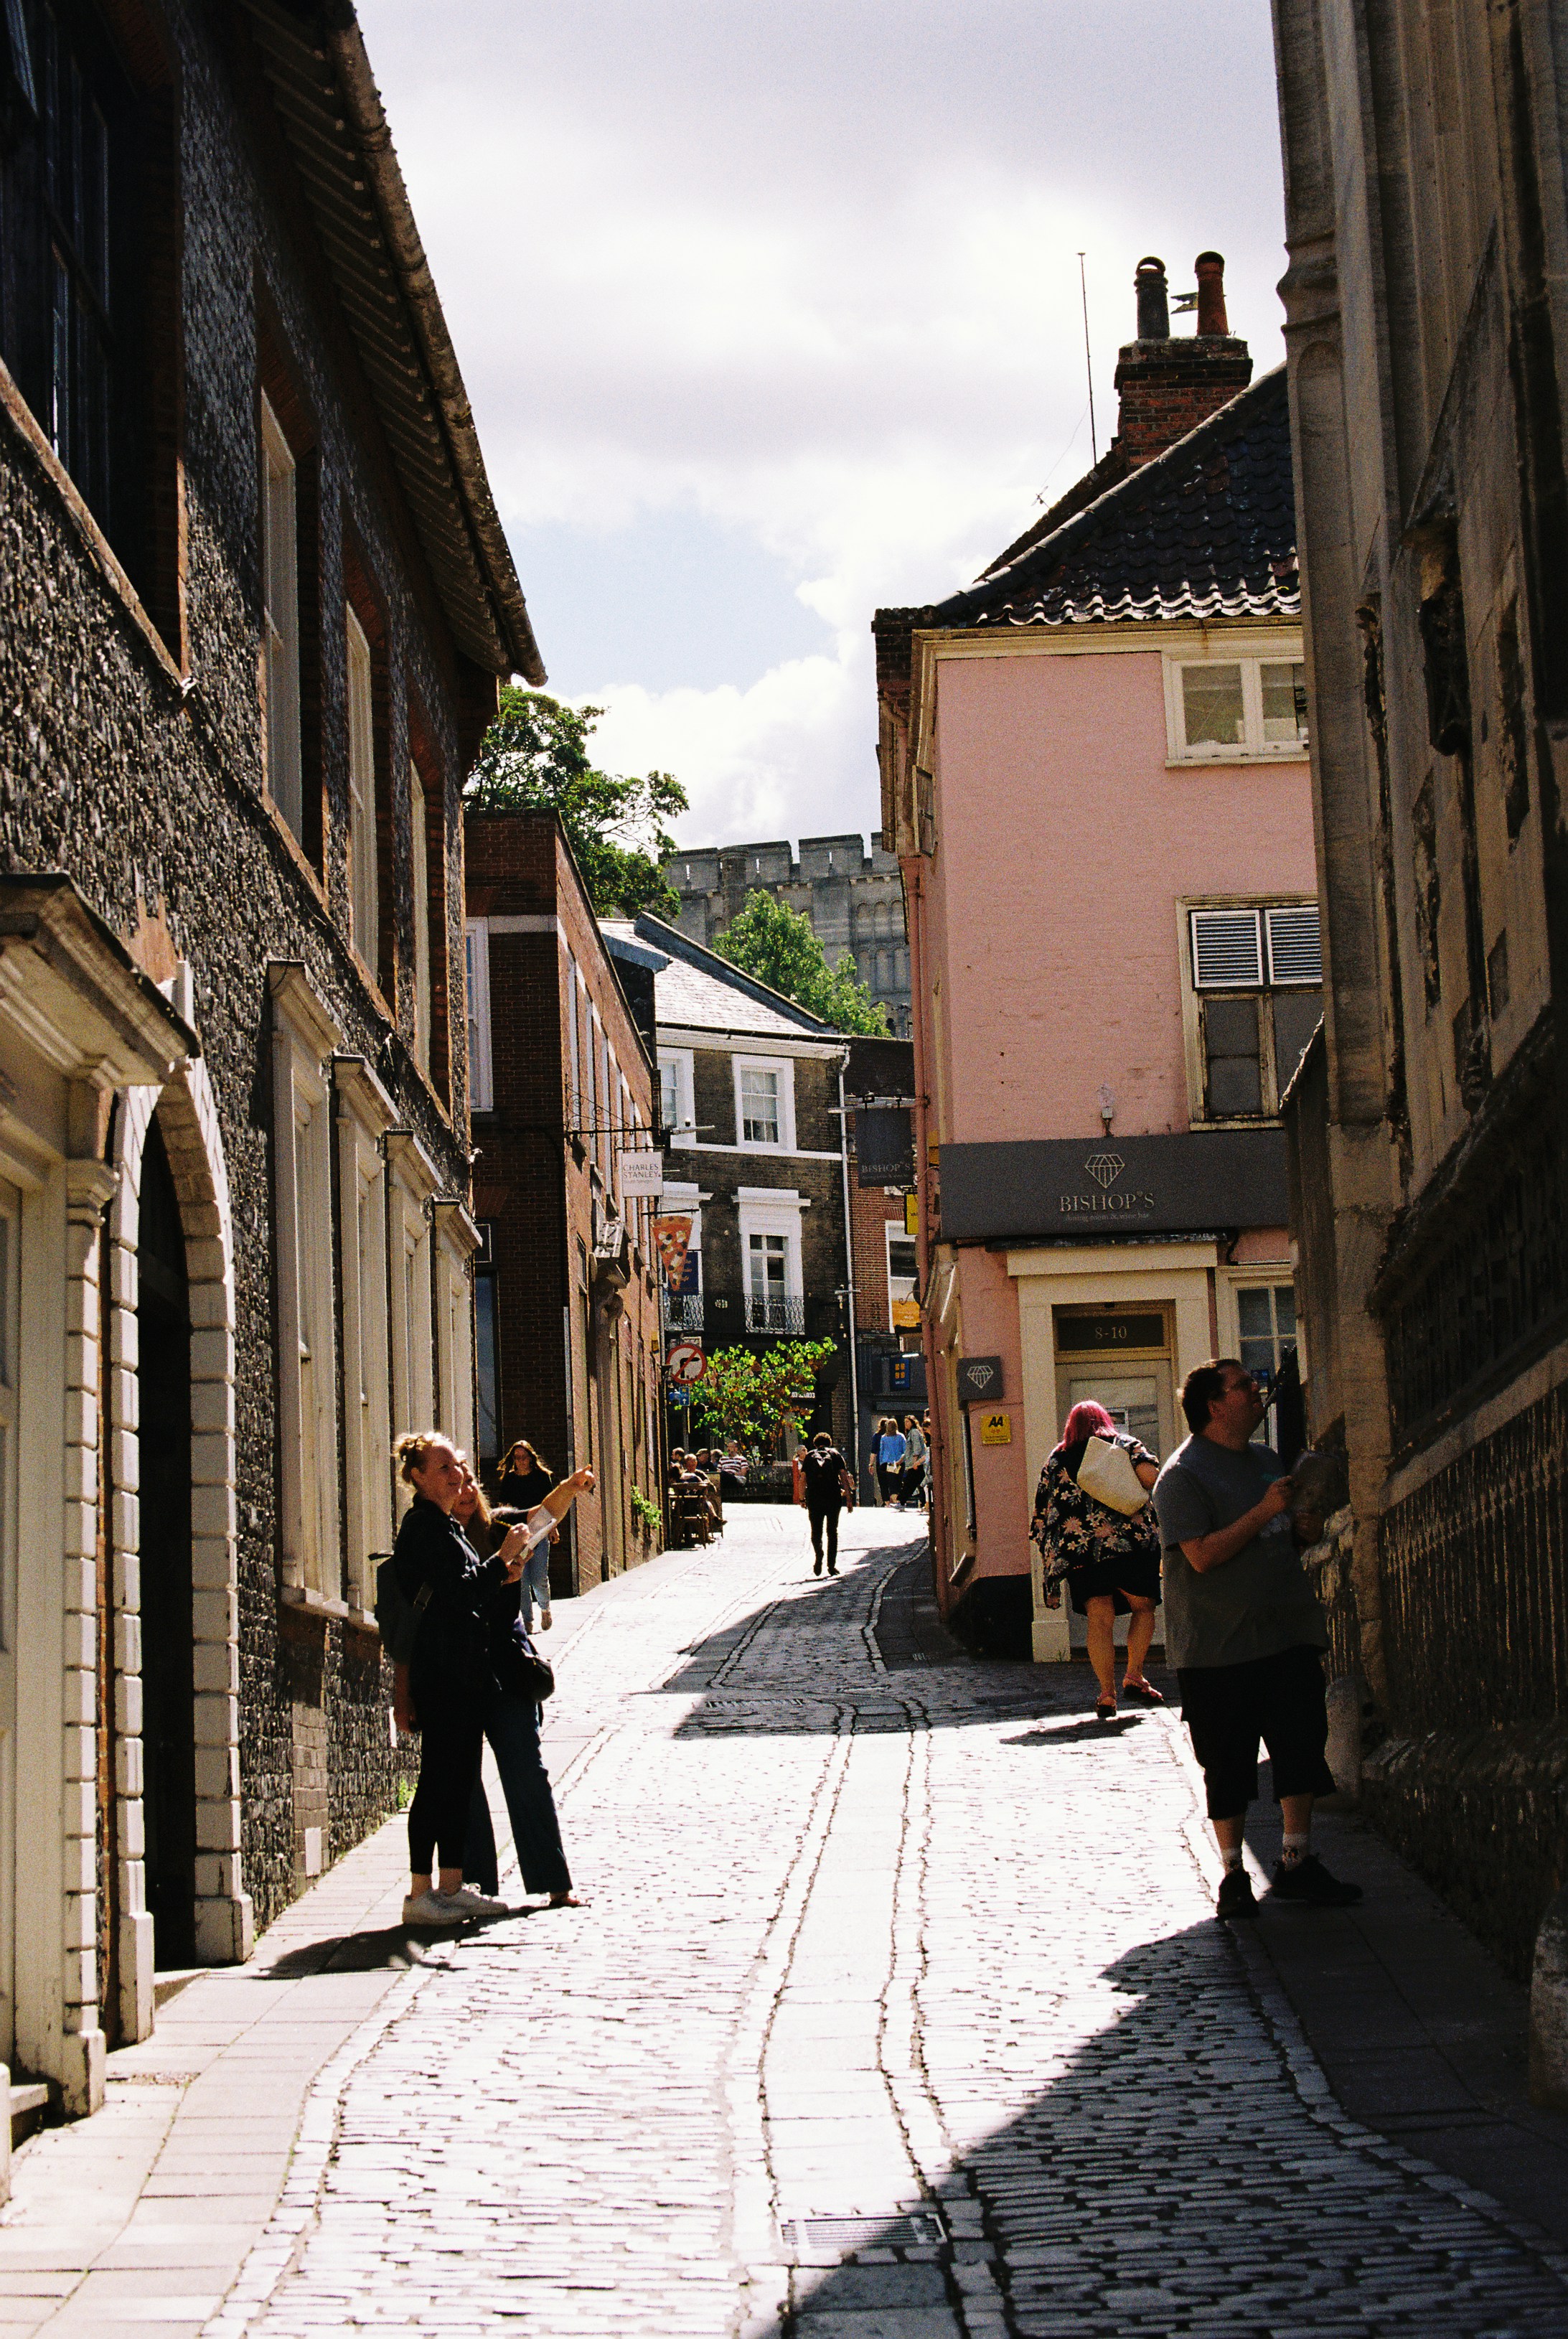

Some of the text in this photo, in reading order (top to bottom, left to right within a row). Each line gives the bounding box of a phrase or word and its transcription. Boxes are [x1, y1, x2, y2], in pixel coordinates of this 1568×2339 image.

[1060, 1191, 1155, 1212] BISHOP'S
[1095, 1326, 1127, 1339] 8-10
[988, 1416, 1003, 1428] AA
